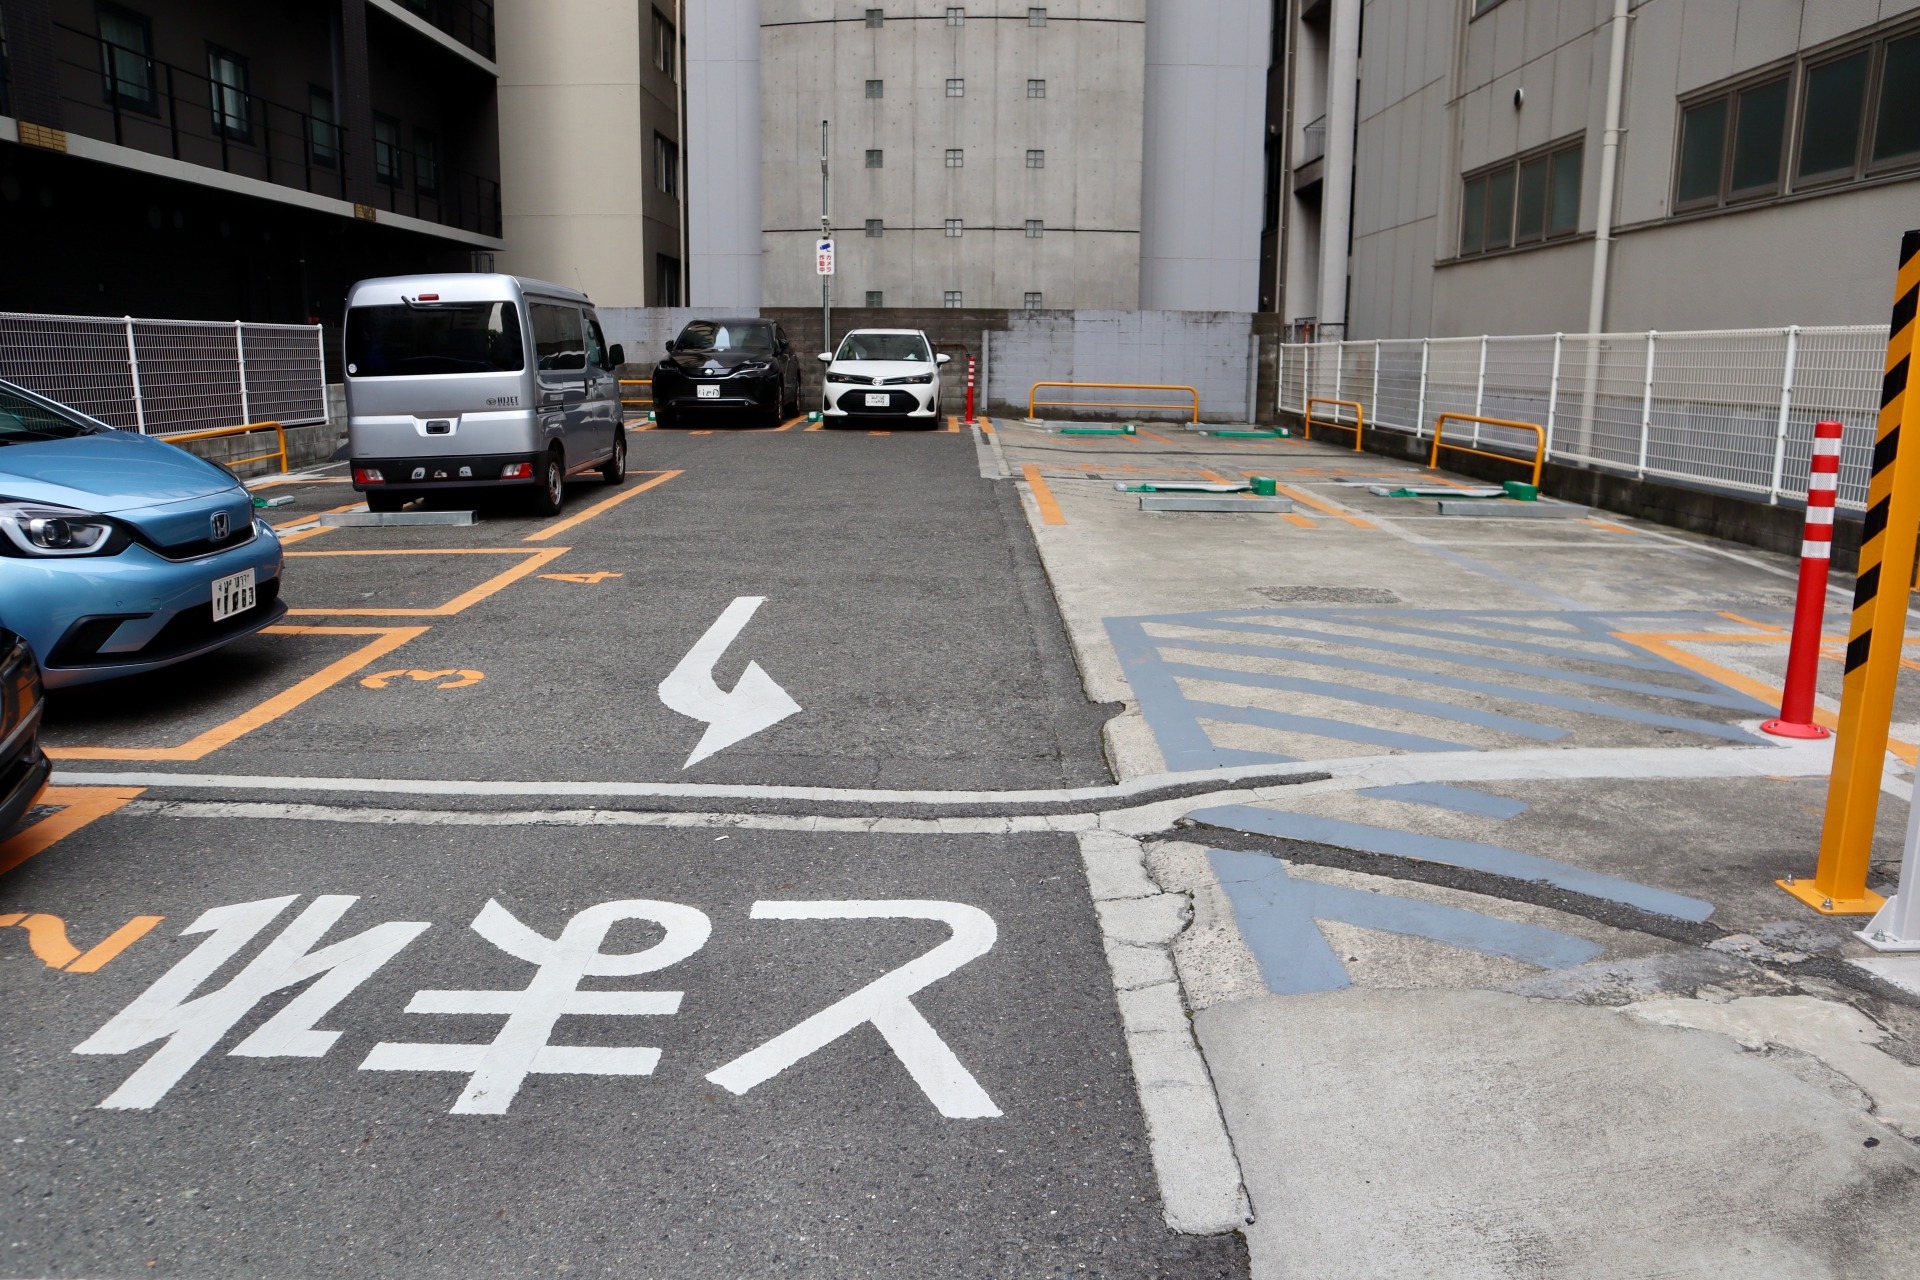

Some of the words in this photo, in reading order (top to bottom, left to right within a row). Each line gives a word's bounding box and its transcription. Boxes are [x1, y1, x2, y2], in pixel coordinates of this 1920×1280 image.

[497, 396, 518, 404] HIJET
[537, 570, 624, 584] 4
[361, 668, 486, 689] 3
[0, 912, 167, 974] 2
[71, 894, 1004, 1121] とまれ
